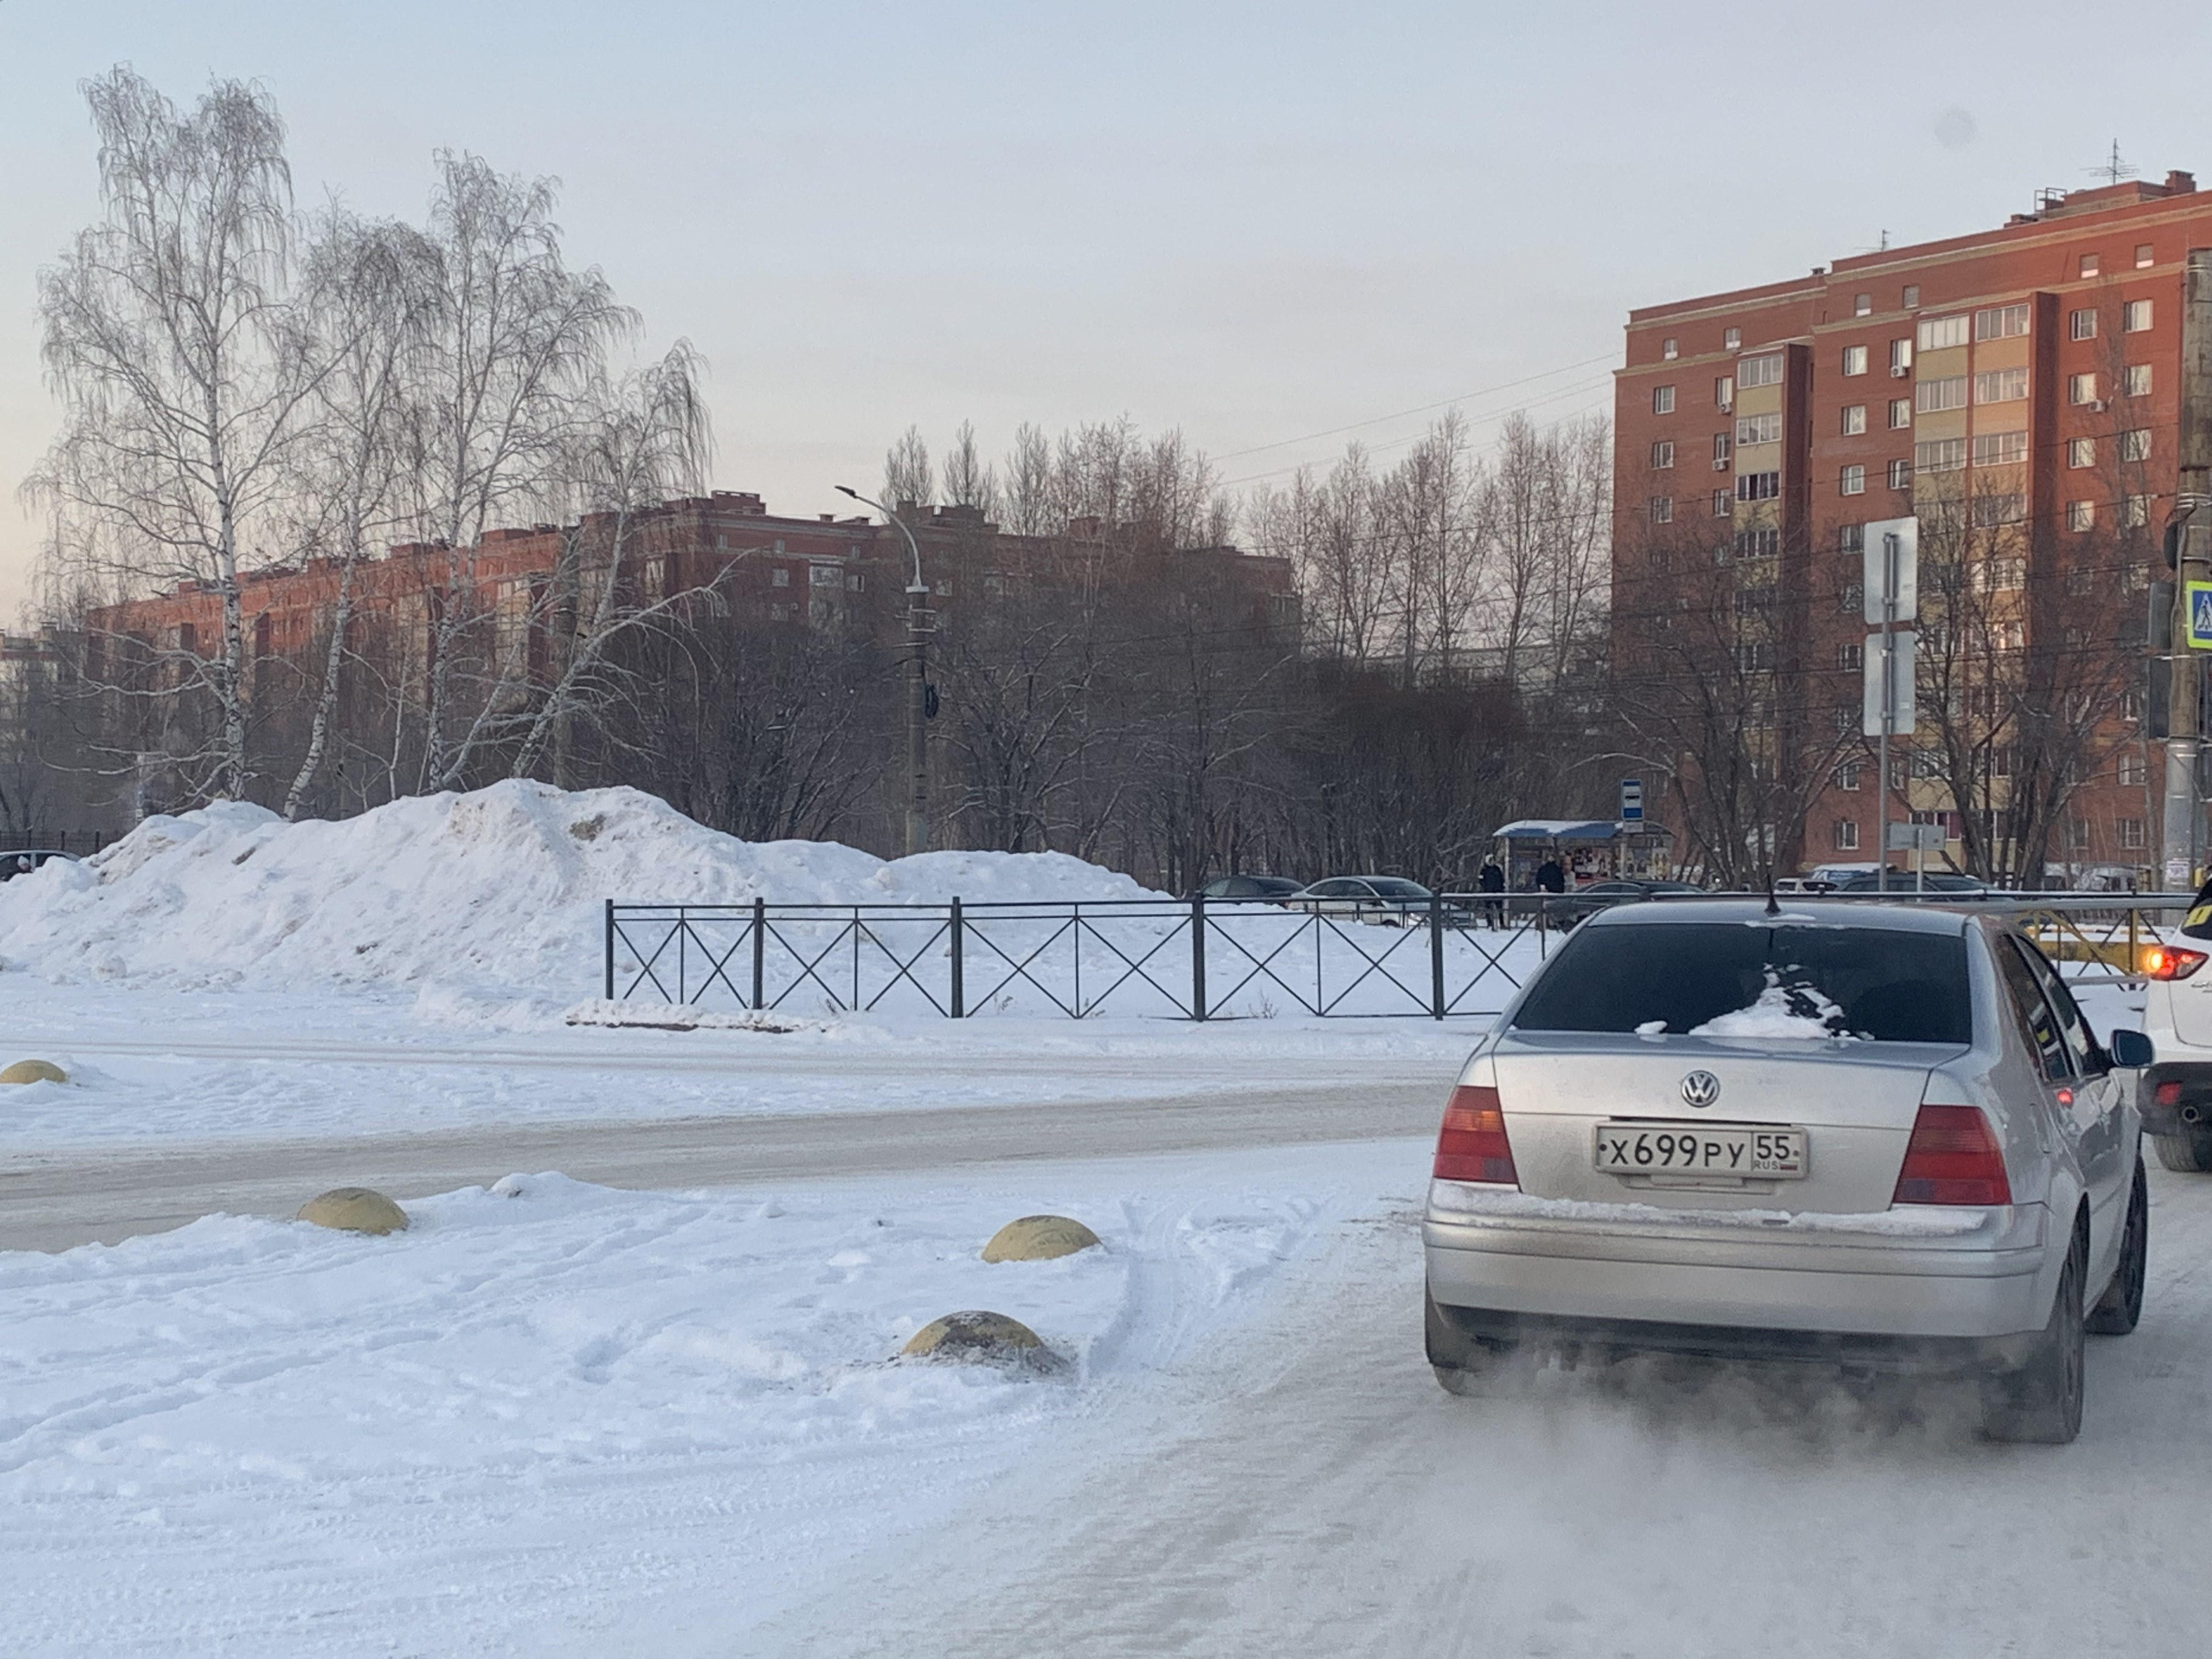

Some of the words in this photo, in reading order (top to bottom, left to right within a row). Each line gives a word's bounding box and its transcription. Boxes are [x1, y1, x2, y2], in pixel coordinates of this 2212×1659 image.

[1610, 1133, 1745, 1167] Х699РУ
[1757, 1135, 1790, 1160] 55
[1755, 1160, 1779, 1170] RUS
